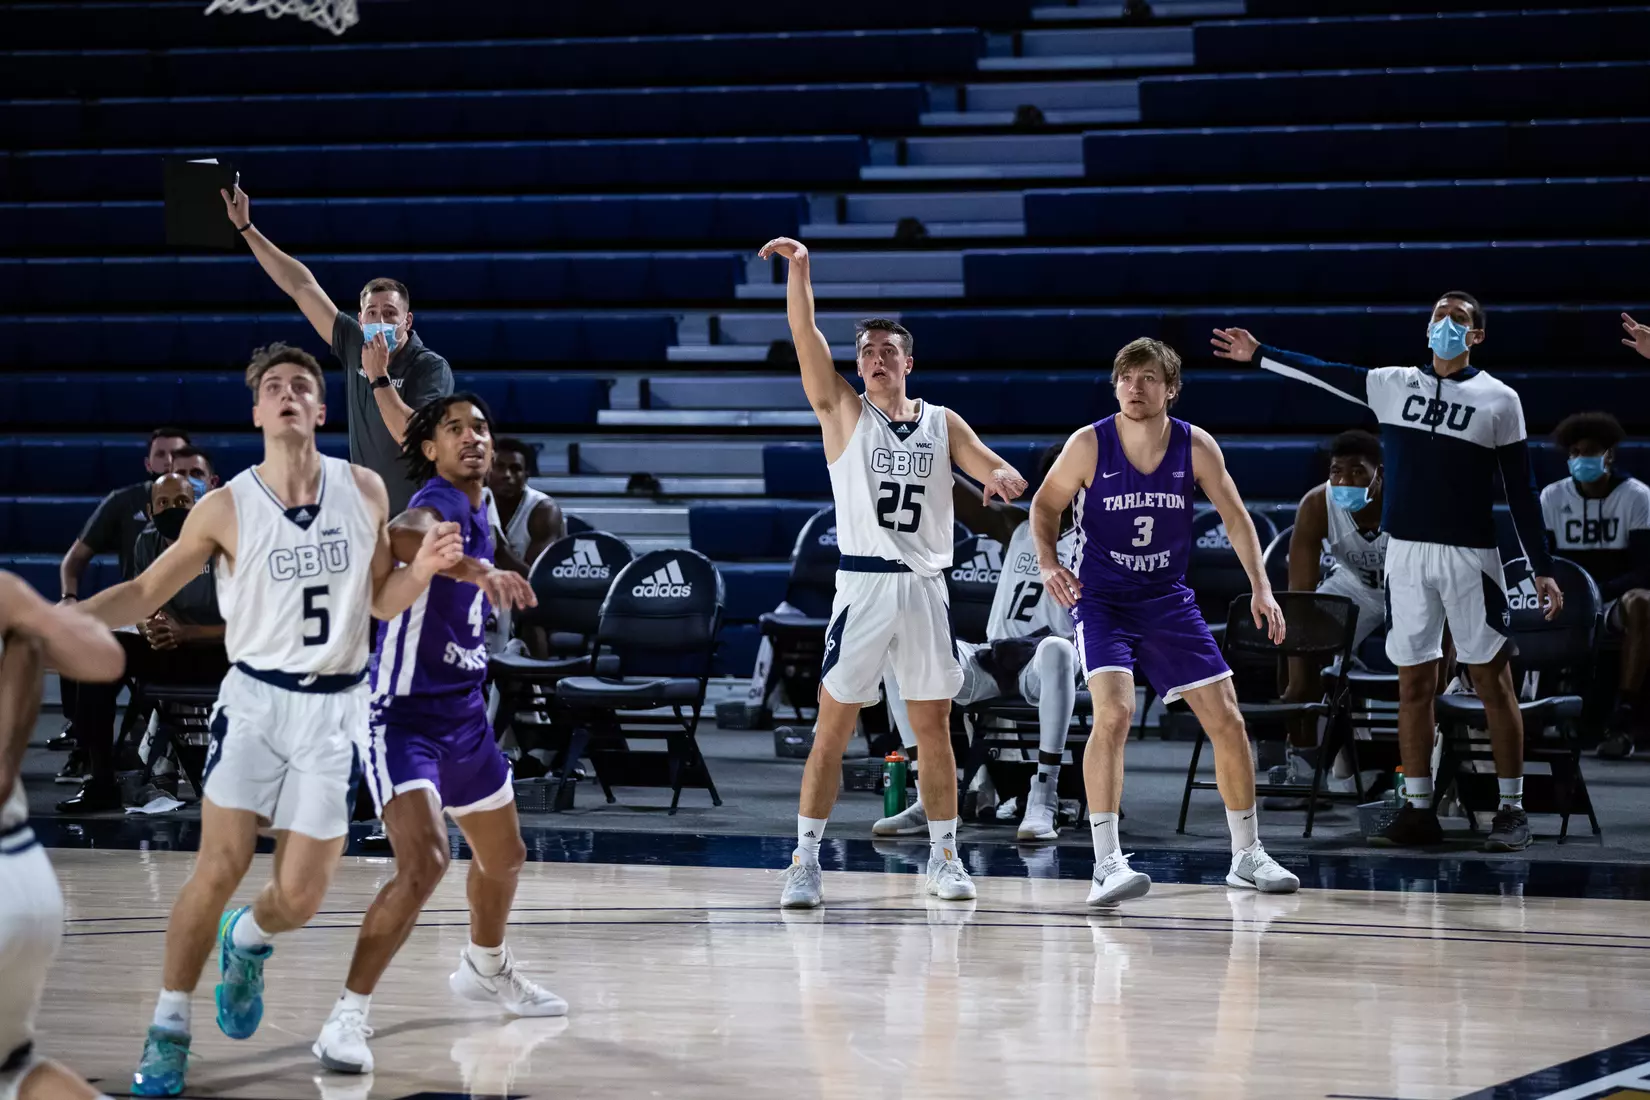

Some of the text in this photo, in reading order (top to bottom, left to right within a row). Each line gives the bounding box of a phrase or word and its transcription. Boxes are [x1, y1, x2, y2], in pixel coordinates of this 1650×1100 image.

[1402, 394, 1477, 431] CBU
[871, 447, 934, 478] CBU
[877, 481, 925, 533] 25
[1102, 491, 1185, 511] TARLETON
[1131, 515, 1155, 547] 3
[1565, 518, 1619, 544] CBU
[268, 539, 350, 582] CBU
[551, 563, 611, 579] adidas
[1014, 552, 1042, 576] CB
[1109, 549, 1171, 572] STATE
[1346, 550, 1384, 569] CB
[951, 568, 1000, 583] adida
[631, 582, 693, 598] adidas
[1006, 580, 1044, 622] 12
[303, 585, 330, 647] 5
[467, 588, 484, 637] 4
